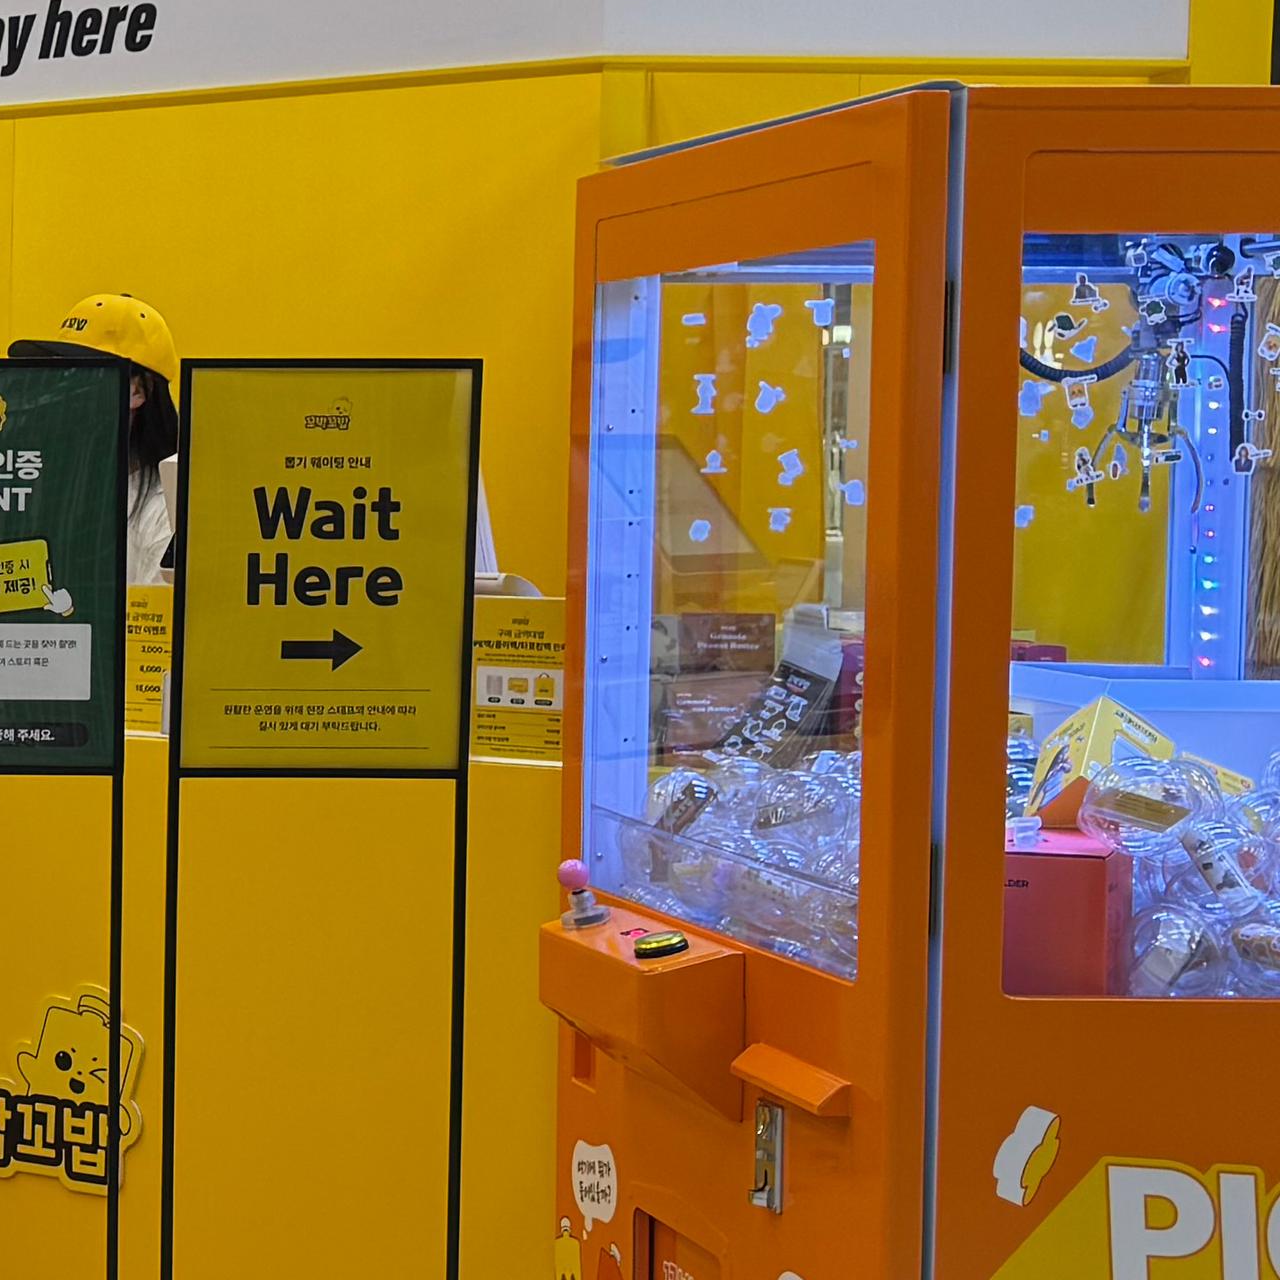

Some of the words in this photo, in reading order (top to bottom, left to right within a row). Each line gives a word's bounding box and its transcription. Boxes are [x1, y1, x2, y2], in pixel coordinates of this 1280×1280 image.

[253, 486, 402, 541] Wait
[4, 578, 37, 596] 제공!
[246, 552, 404, 606] Here
[1004, 879, 1030, 888] DER
